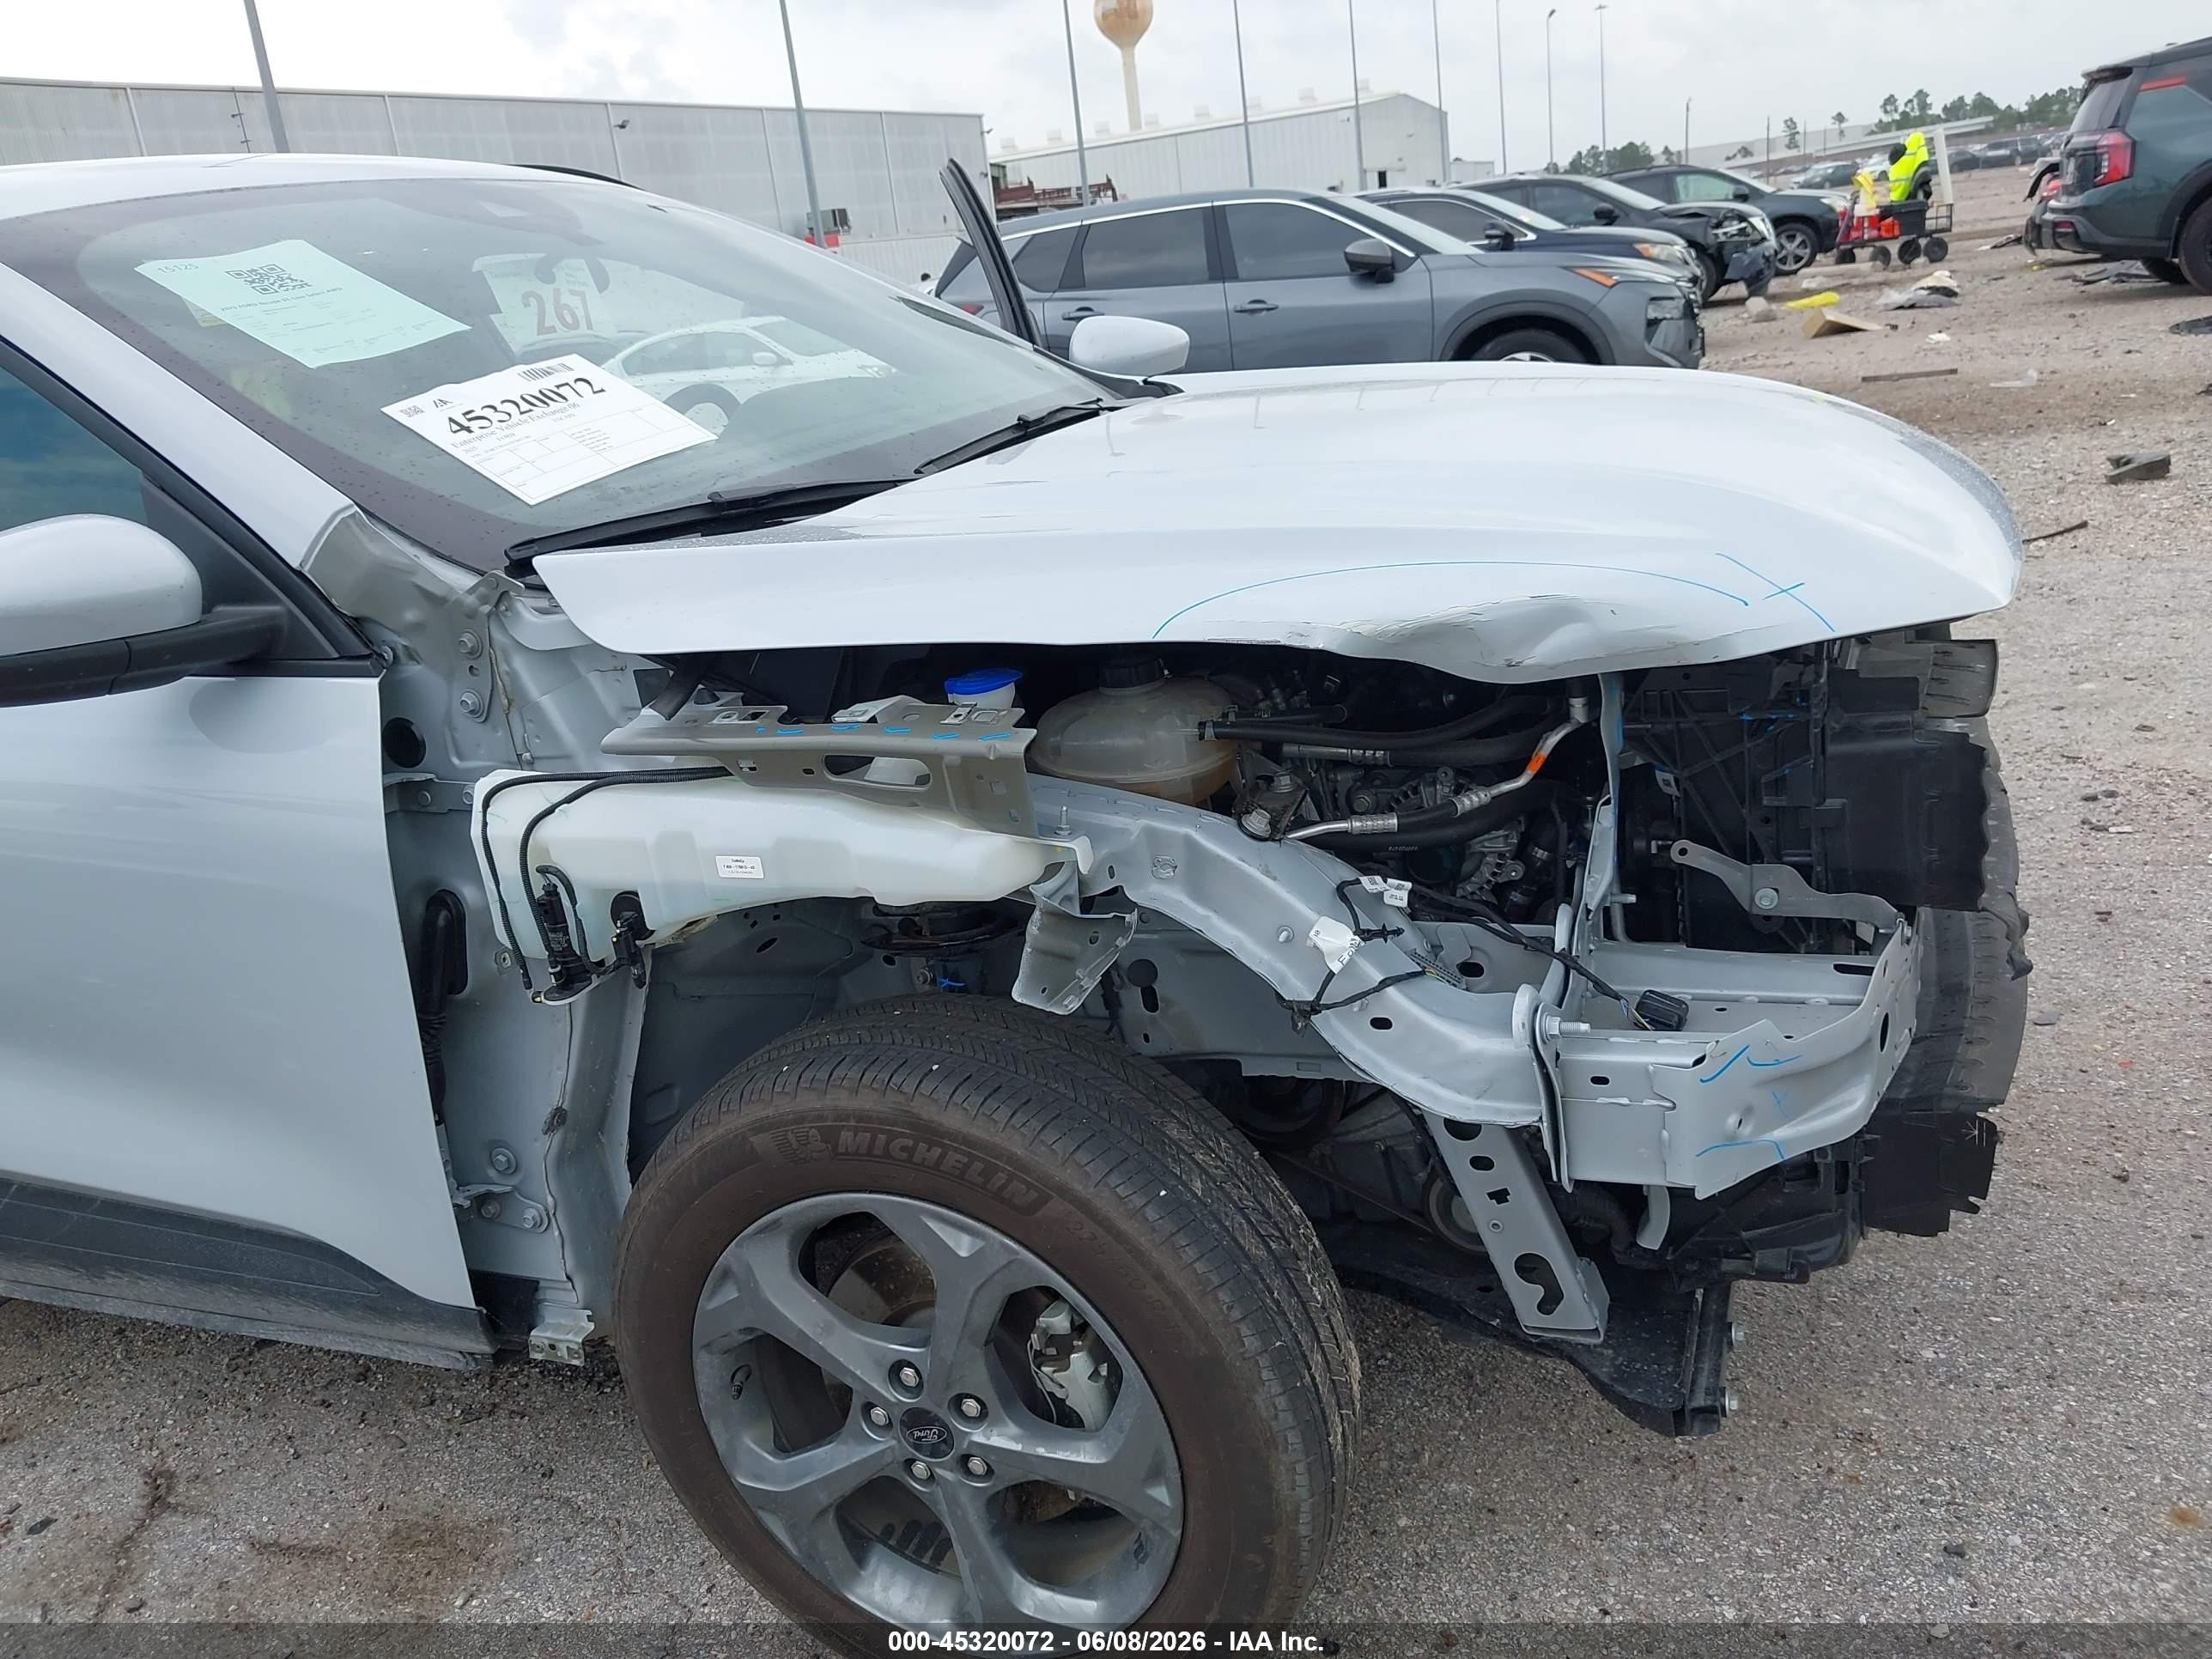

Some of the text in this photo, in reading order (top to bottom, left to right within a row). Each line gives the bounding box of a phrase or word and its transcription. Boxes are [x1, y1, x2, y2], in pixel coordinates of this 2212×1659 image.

[521, 288, 594, 337] 267
[448, 377, 606, 435] 45320072
[837, 1130, 1040, 1206] MICHELIN
[913, 1429, 939, 1442] Ford
